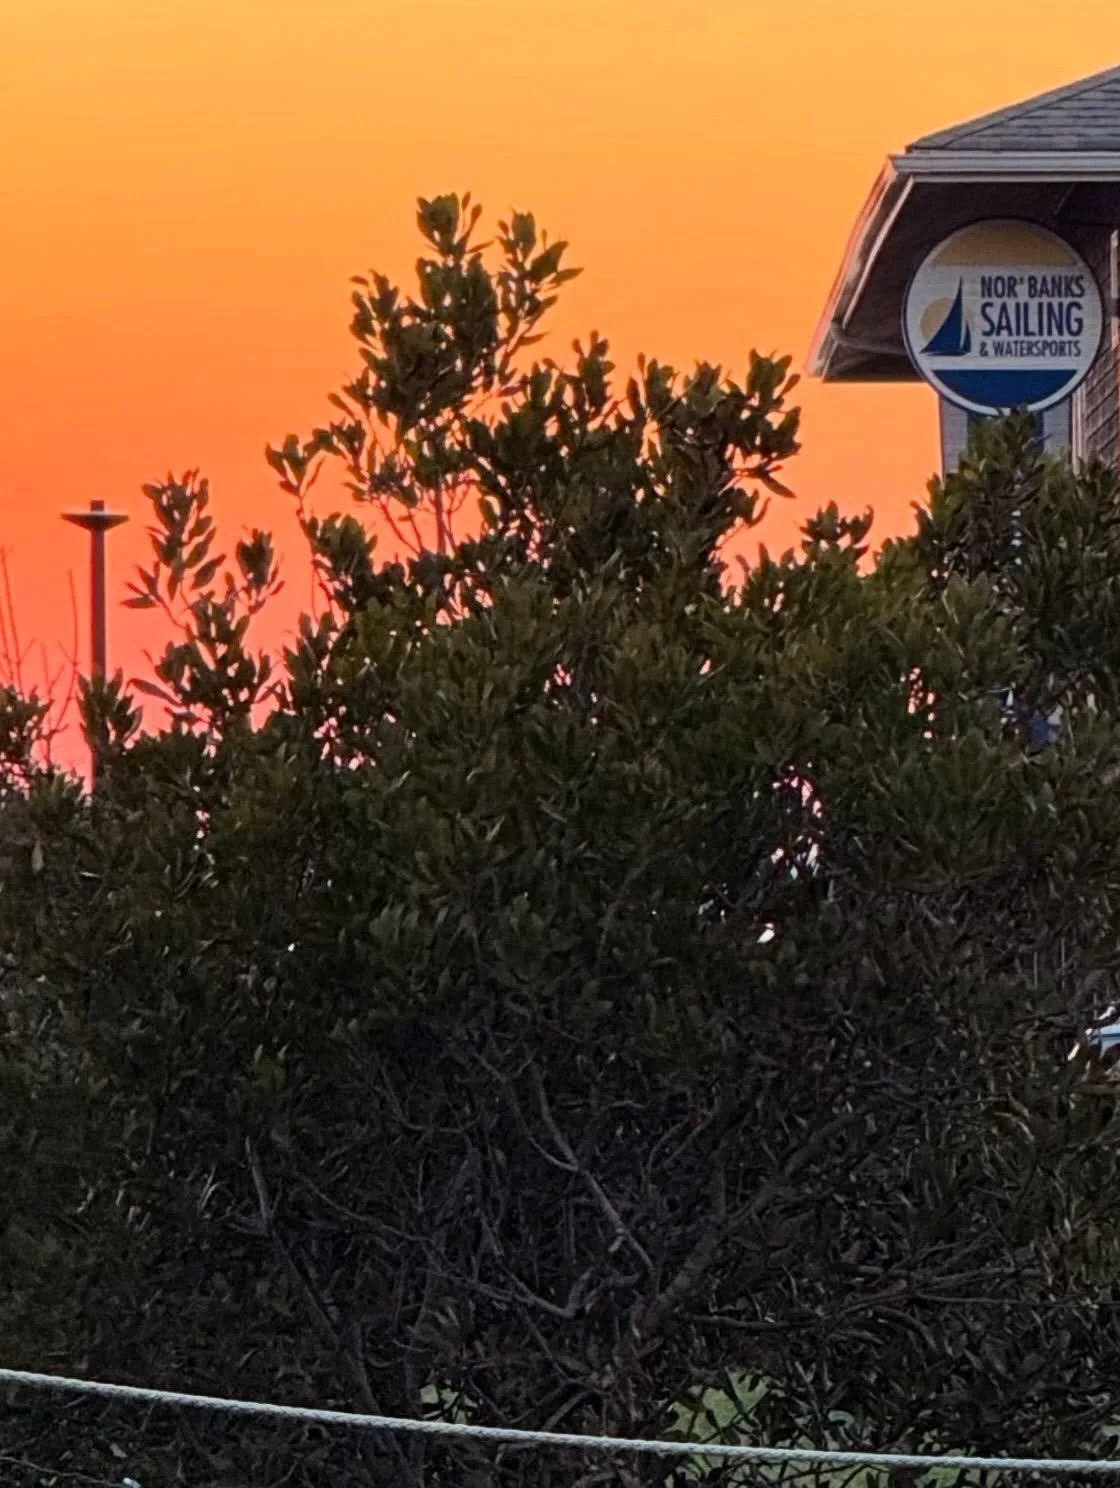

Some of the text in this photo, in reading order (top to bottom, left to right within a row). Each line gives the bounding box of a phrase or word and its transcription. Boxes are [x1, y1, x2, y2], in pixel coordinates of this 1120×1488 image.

[981, 302, 1084, 337] SAILING
[979, 340, 1081, 357] & WATERSPORTS
